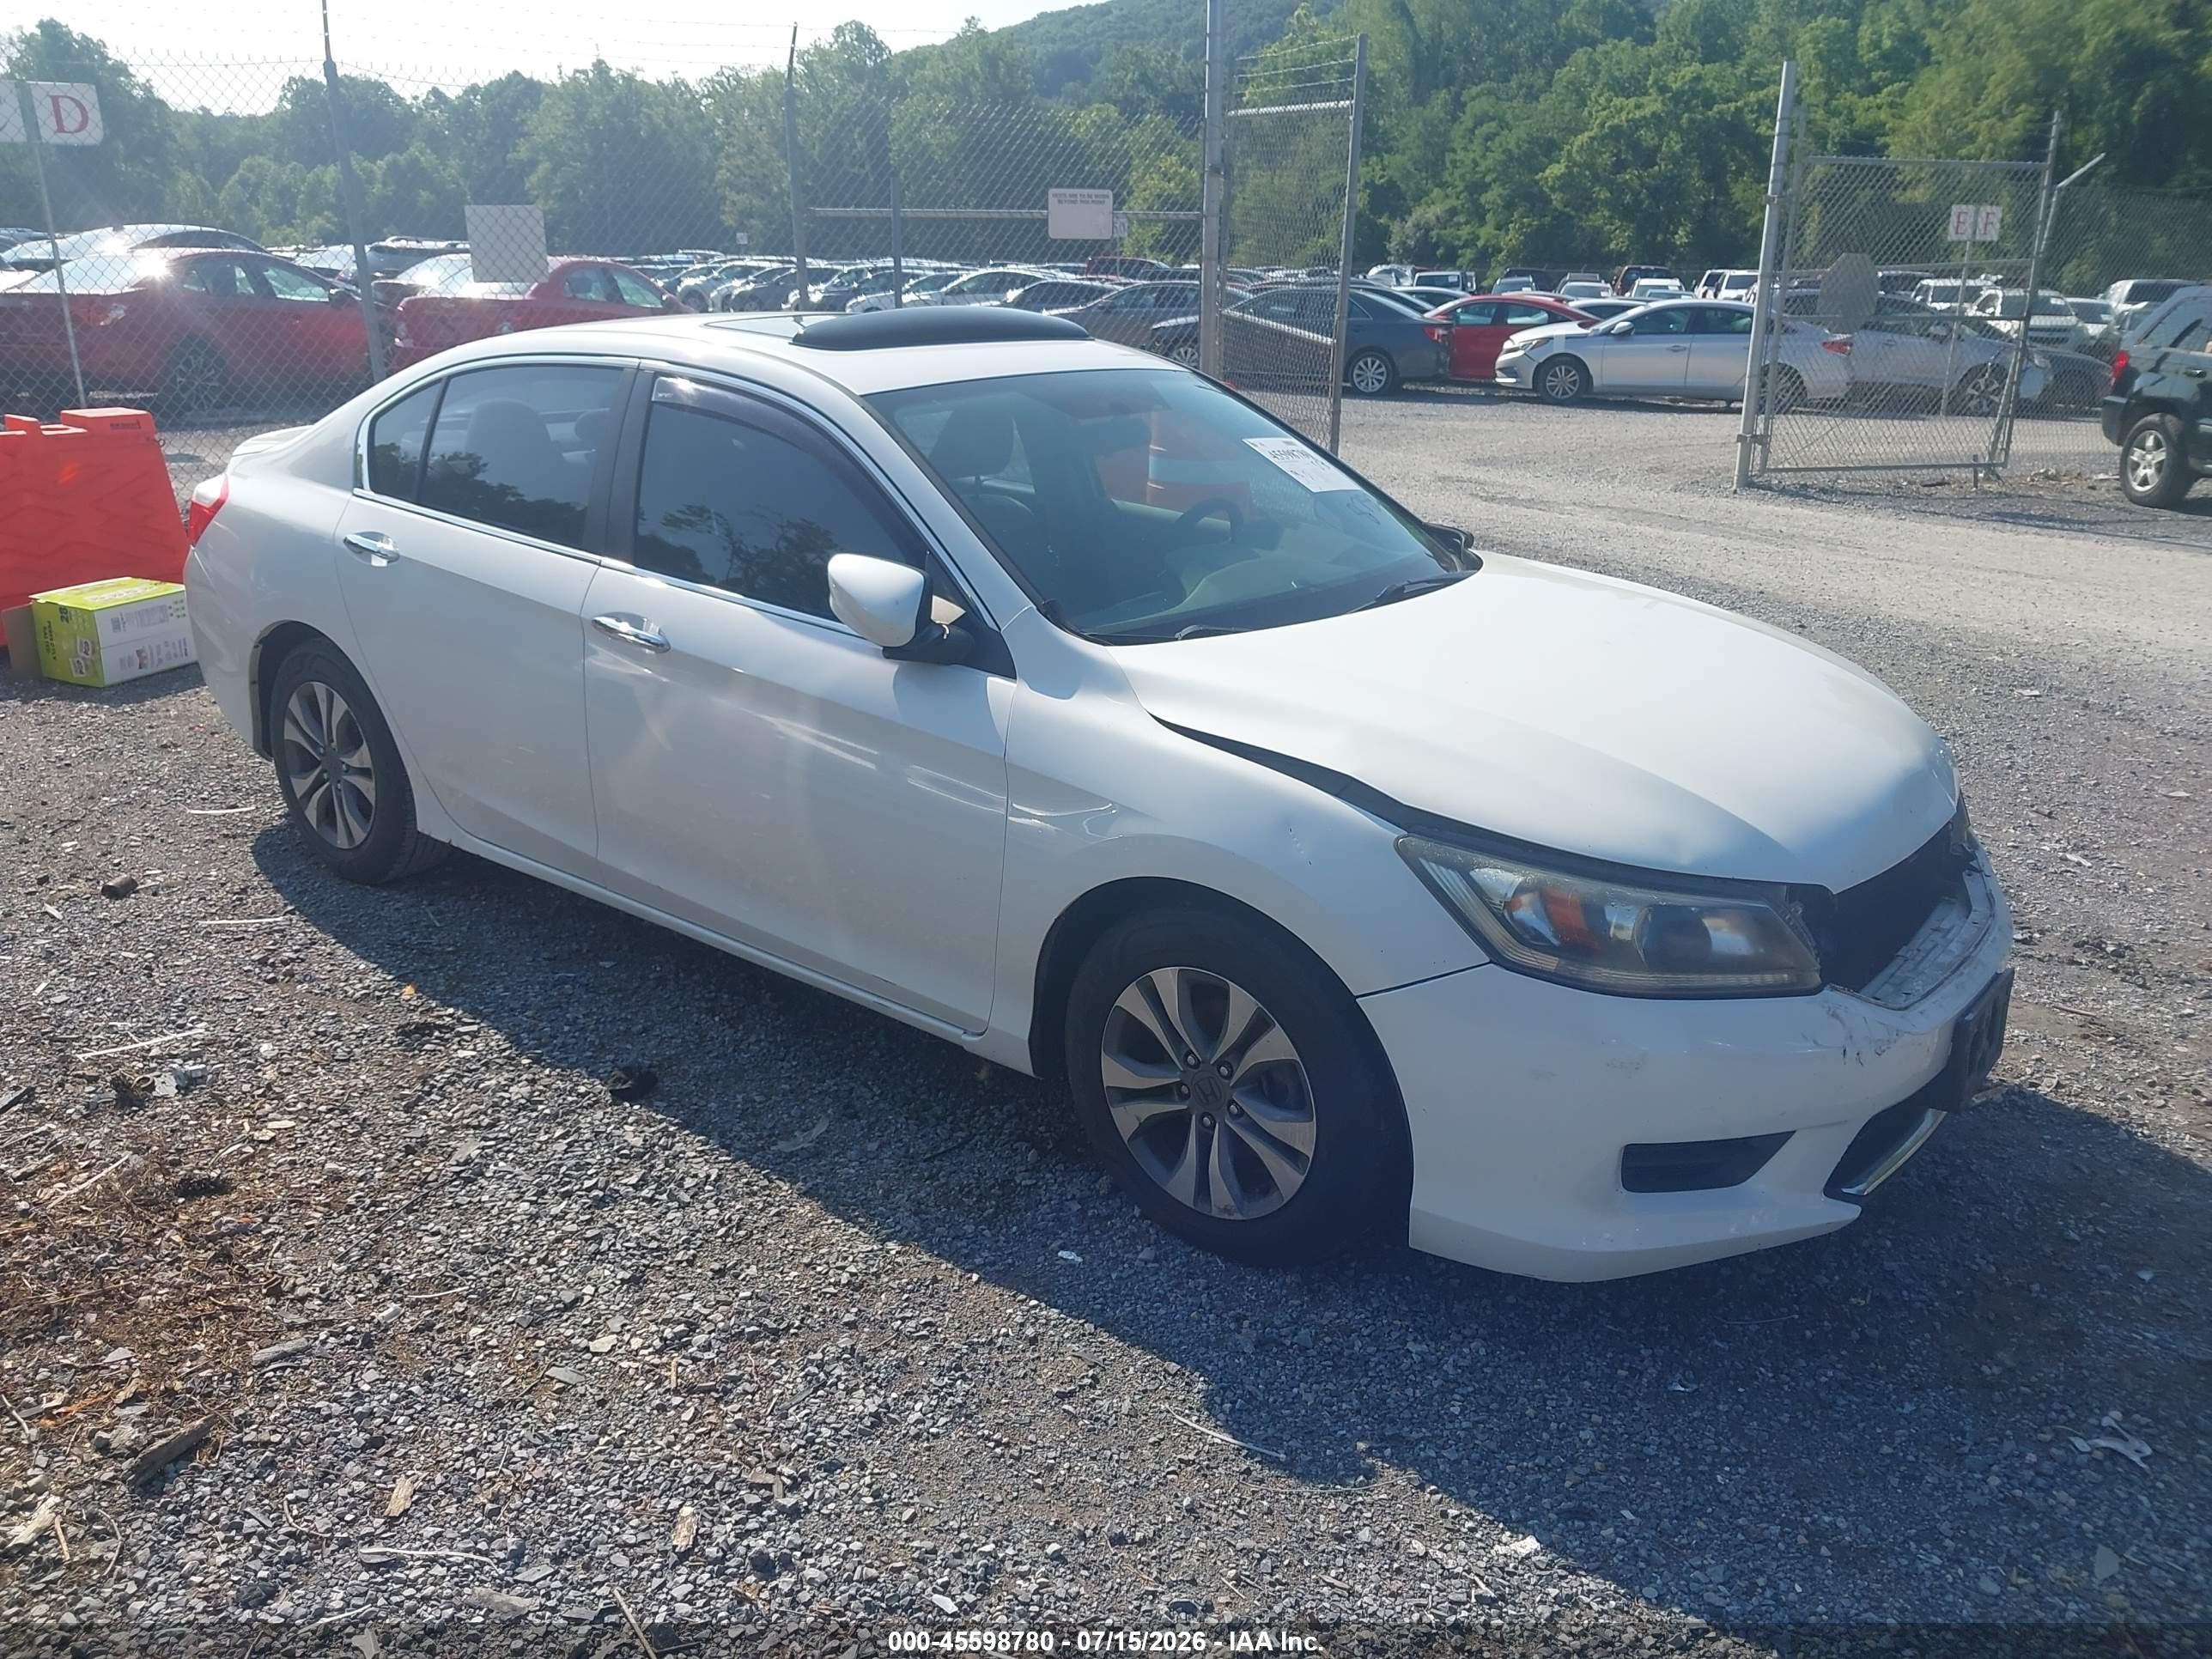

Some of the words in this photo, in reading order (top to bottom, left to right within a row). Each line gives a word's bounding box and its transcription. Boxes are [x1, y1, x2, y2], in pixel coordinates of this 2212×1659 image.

[47, 94, 88, 134] D
[1954, 211, 1968, 234] E
[1981, 211, 1996, 234] F
